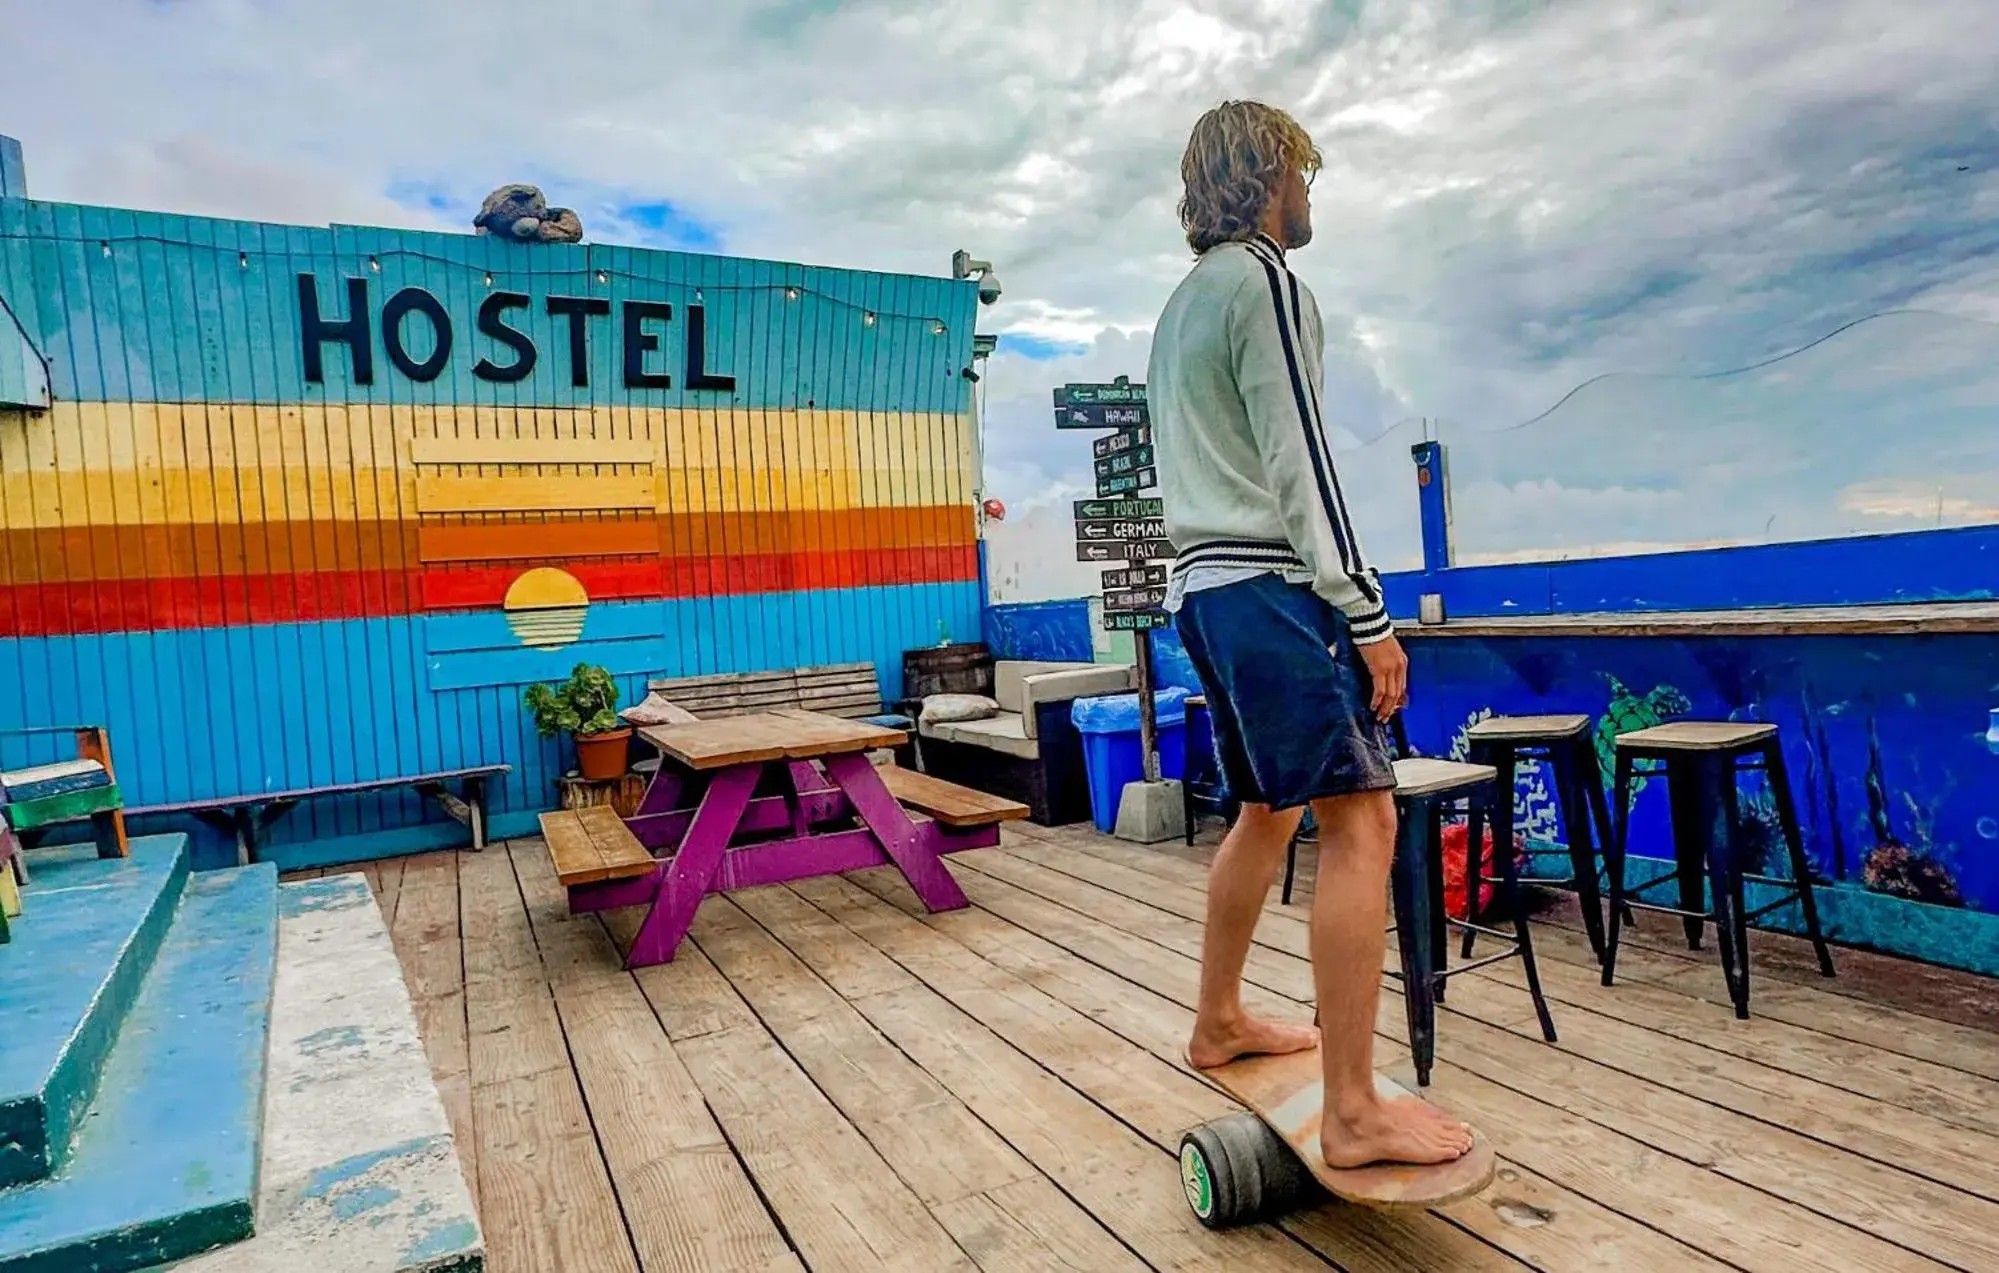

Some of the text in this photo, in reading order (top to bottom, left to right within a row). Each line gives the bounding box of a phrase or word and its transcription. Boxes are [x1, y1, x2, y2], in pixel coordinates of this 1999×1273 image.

[297, 272, 737, 391] HOSTEL
[1105, 409, 1140, 423] HAWAII
[1113, 500, 1164, 516] PORTUGAL
[1113, 522, 1165, 538] GERMAN
[1123, 543, 1157, 558] ITALY
